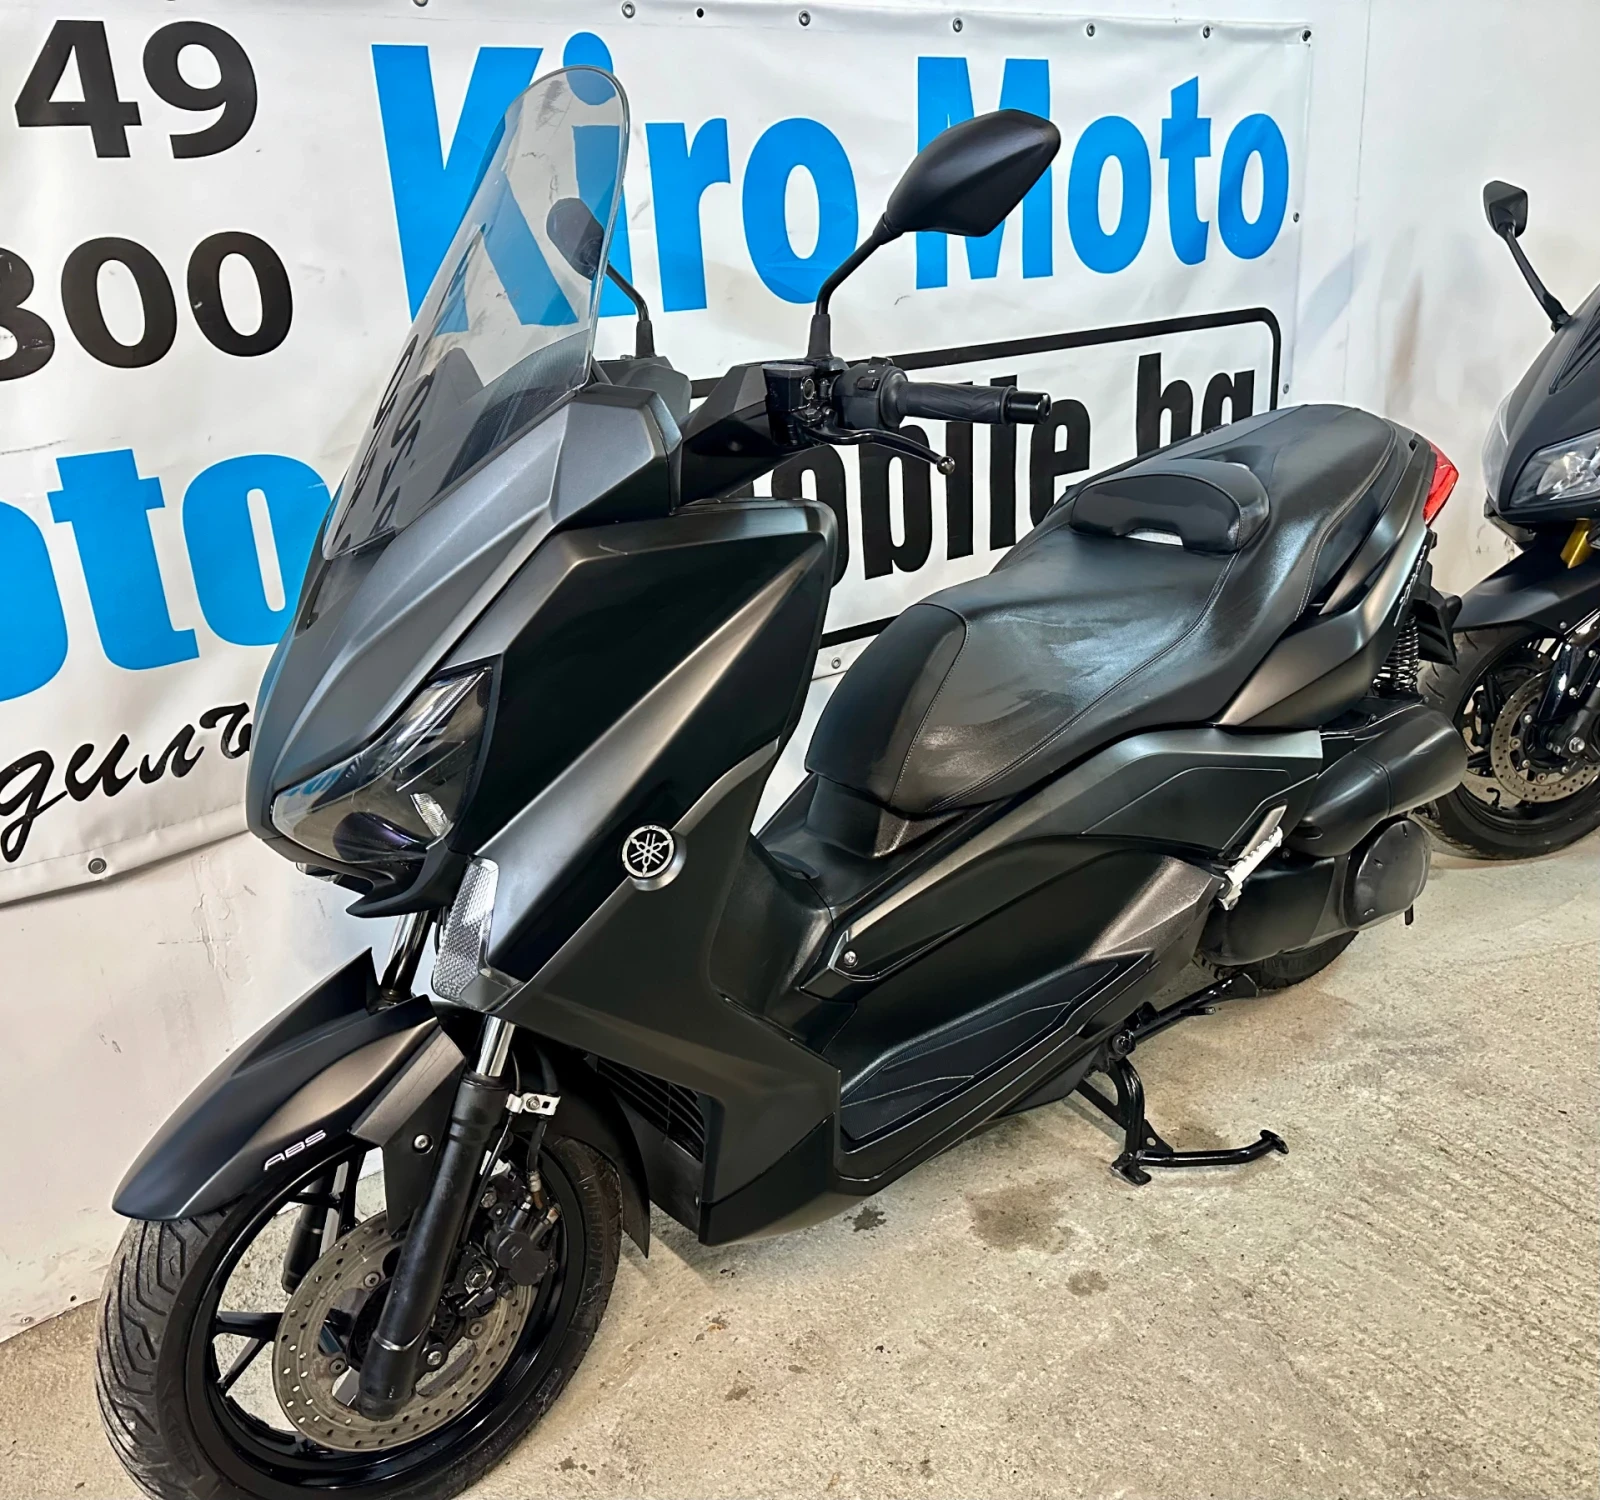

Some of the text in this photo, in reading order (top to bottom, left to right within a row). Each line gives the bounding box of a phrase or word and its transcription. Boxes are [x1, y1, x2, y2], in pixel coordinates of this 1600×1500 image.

[15, 20, 257, 159] 49
[371, 32, 1289, 333] Kiro Moto
[264, 1129, 327, 1171] ABS
